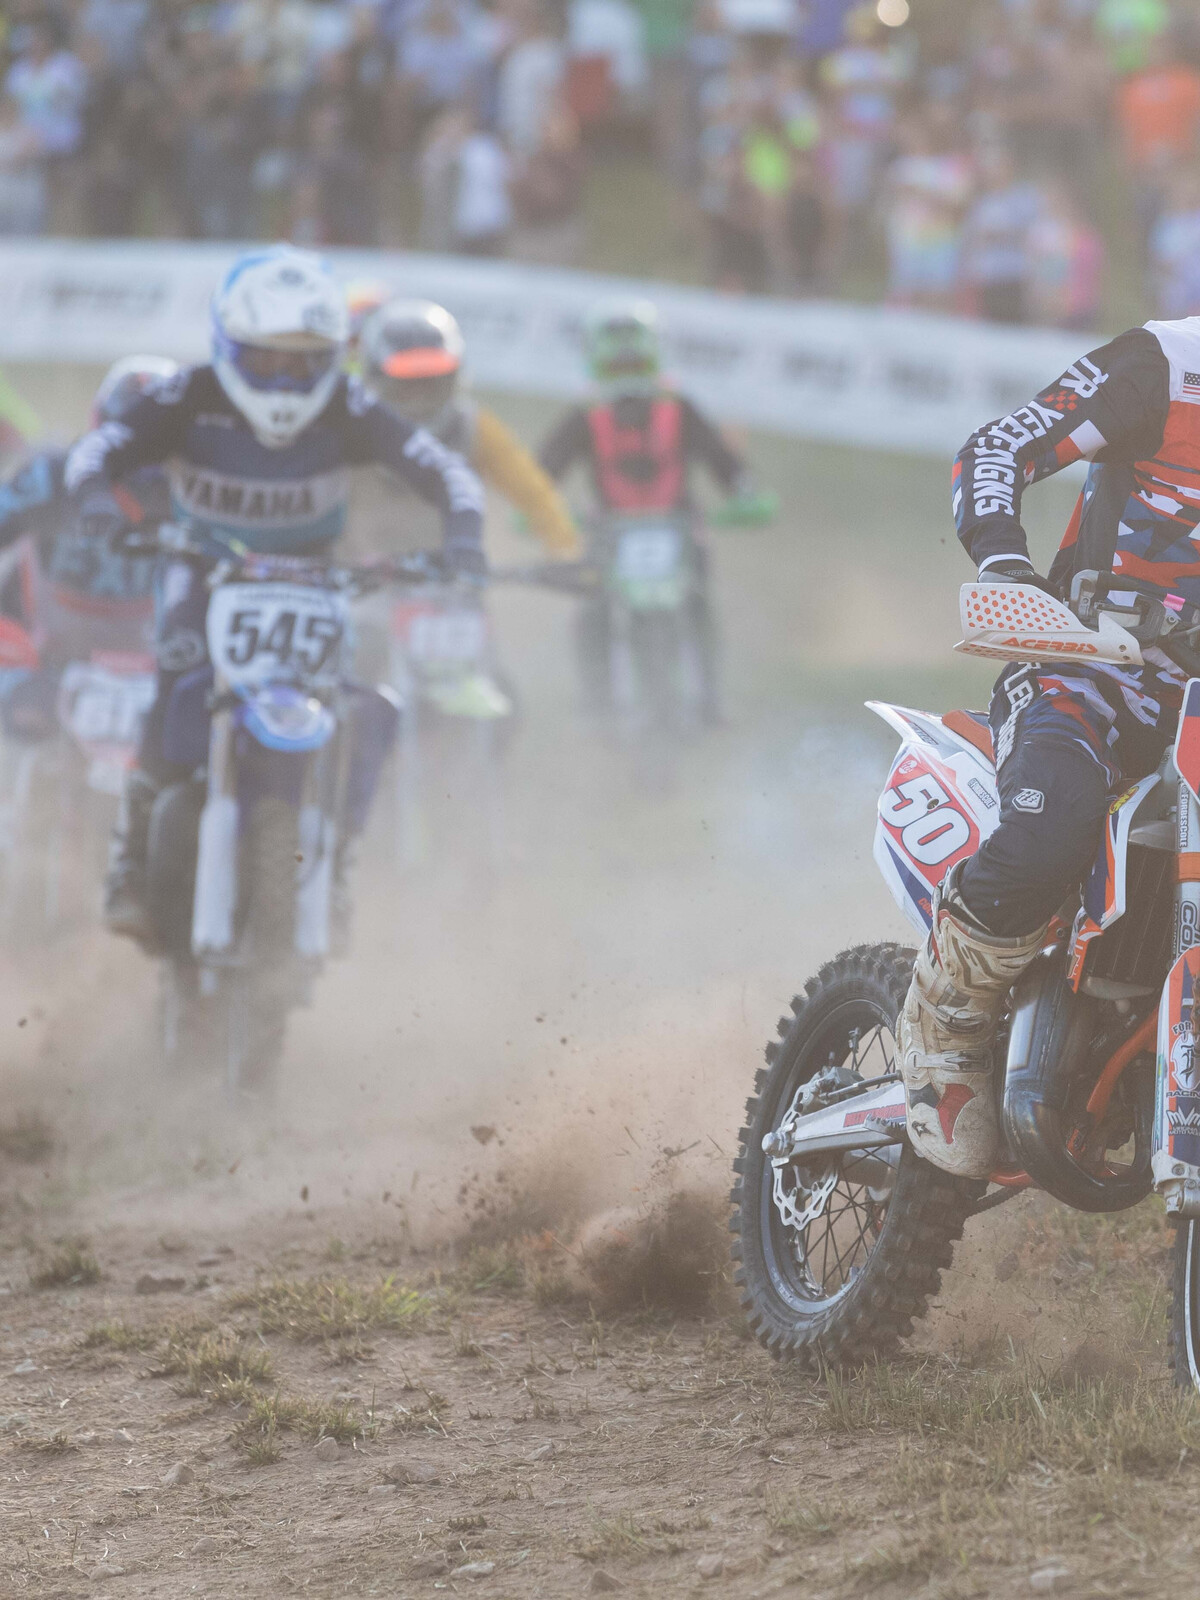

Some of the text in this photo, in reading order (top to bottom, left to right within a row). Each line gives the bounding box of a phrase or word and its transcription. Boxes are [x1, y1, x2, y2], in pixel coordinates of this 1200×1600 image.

[182, 470, 315, 519] YAMAHA
[227, 608, 344, 674] 545
[1000, 637, 1099, 655] ACERBIS
[879, 771, 971, 867] 50
